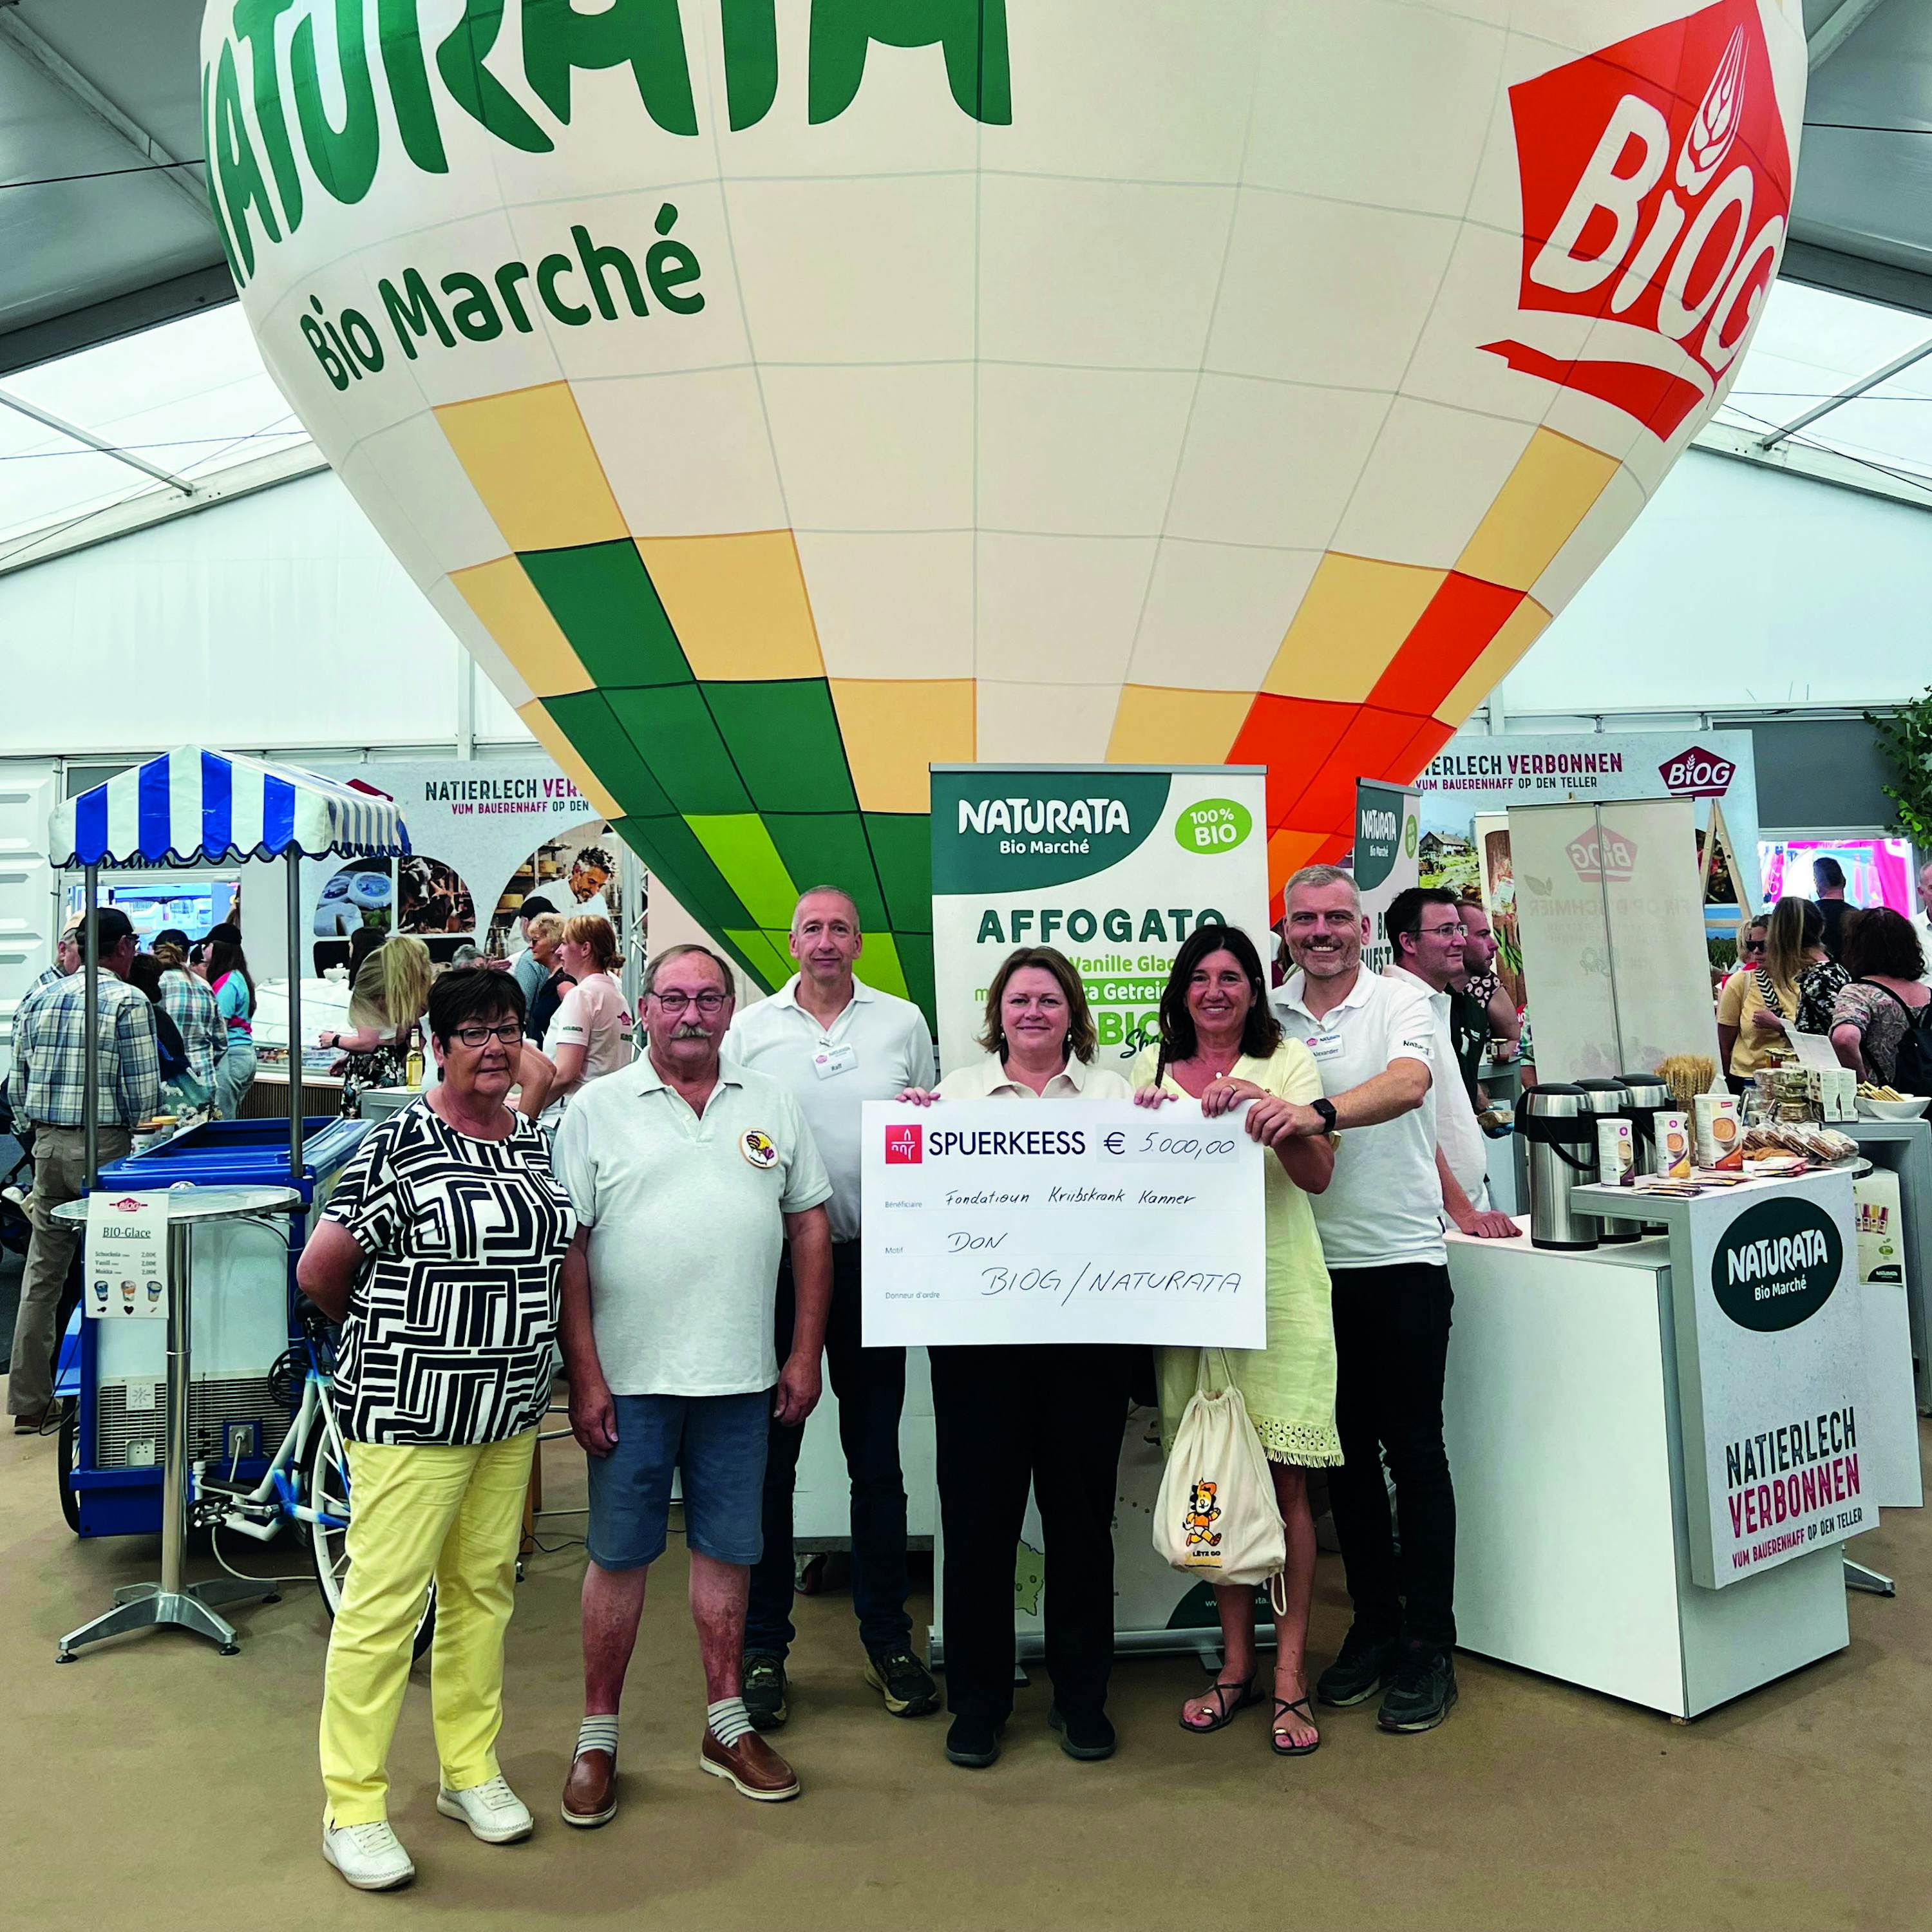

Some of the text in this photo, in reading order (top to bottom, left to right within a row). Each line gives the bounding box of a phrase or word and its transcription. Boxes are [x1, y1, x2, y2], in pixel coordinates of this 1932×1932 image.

[301, 202, 706, 392] Bio Marché
[1508, 753, 1623, 775] VERBONNEN
[426, 779, 537, 801] NATIERLECH
[1416, 777, 1598, 790] VUM BAUERENHAFF OP DEN TELLER
[451, 800, 589, 815] VUM BAUERENHAFF OP DEN
[958, 798, 1130, 835] NATURATA
[1195, 823, 1237, 847] BIO
[1361, 809, 1396, 842] NATURATA
[999, 838, 1090, 855] Bio Marché
[1103, 981, 1167, 1000] Getrei
[929, 1131, 1085, 1156] SPUERKEESS
[1103, 1132, 1125, 1155] €
[945, 1189, 1030, 1206] Fondatioun
[1139, 1190, 1197, 1204] Kanner
[102, 1227, 151, 1238] BIO-Glace
[948, 1232, 1009, 1253] DON
[1727, 1229, 1828, 1286] NATURATA
[1755, 1274, 1807, 1301] Bio Marché
[1726, 1406, 1856, 1489] NATIERLECH
[1728, 1453, 1861, 1539] VERBONNEN
[1732, 1507, 1863, 1569] VUM BAUERENHAFF OP DEN TELLER
